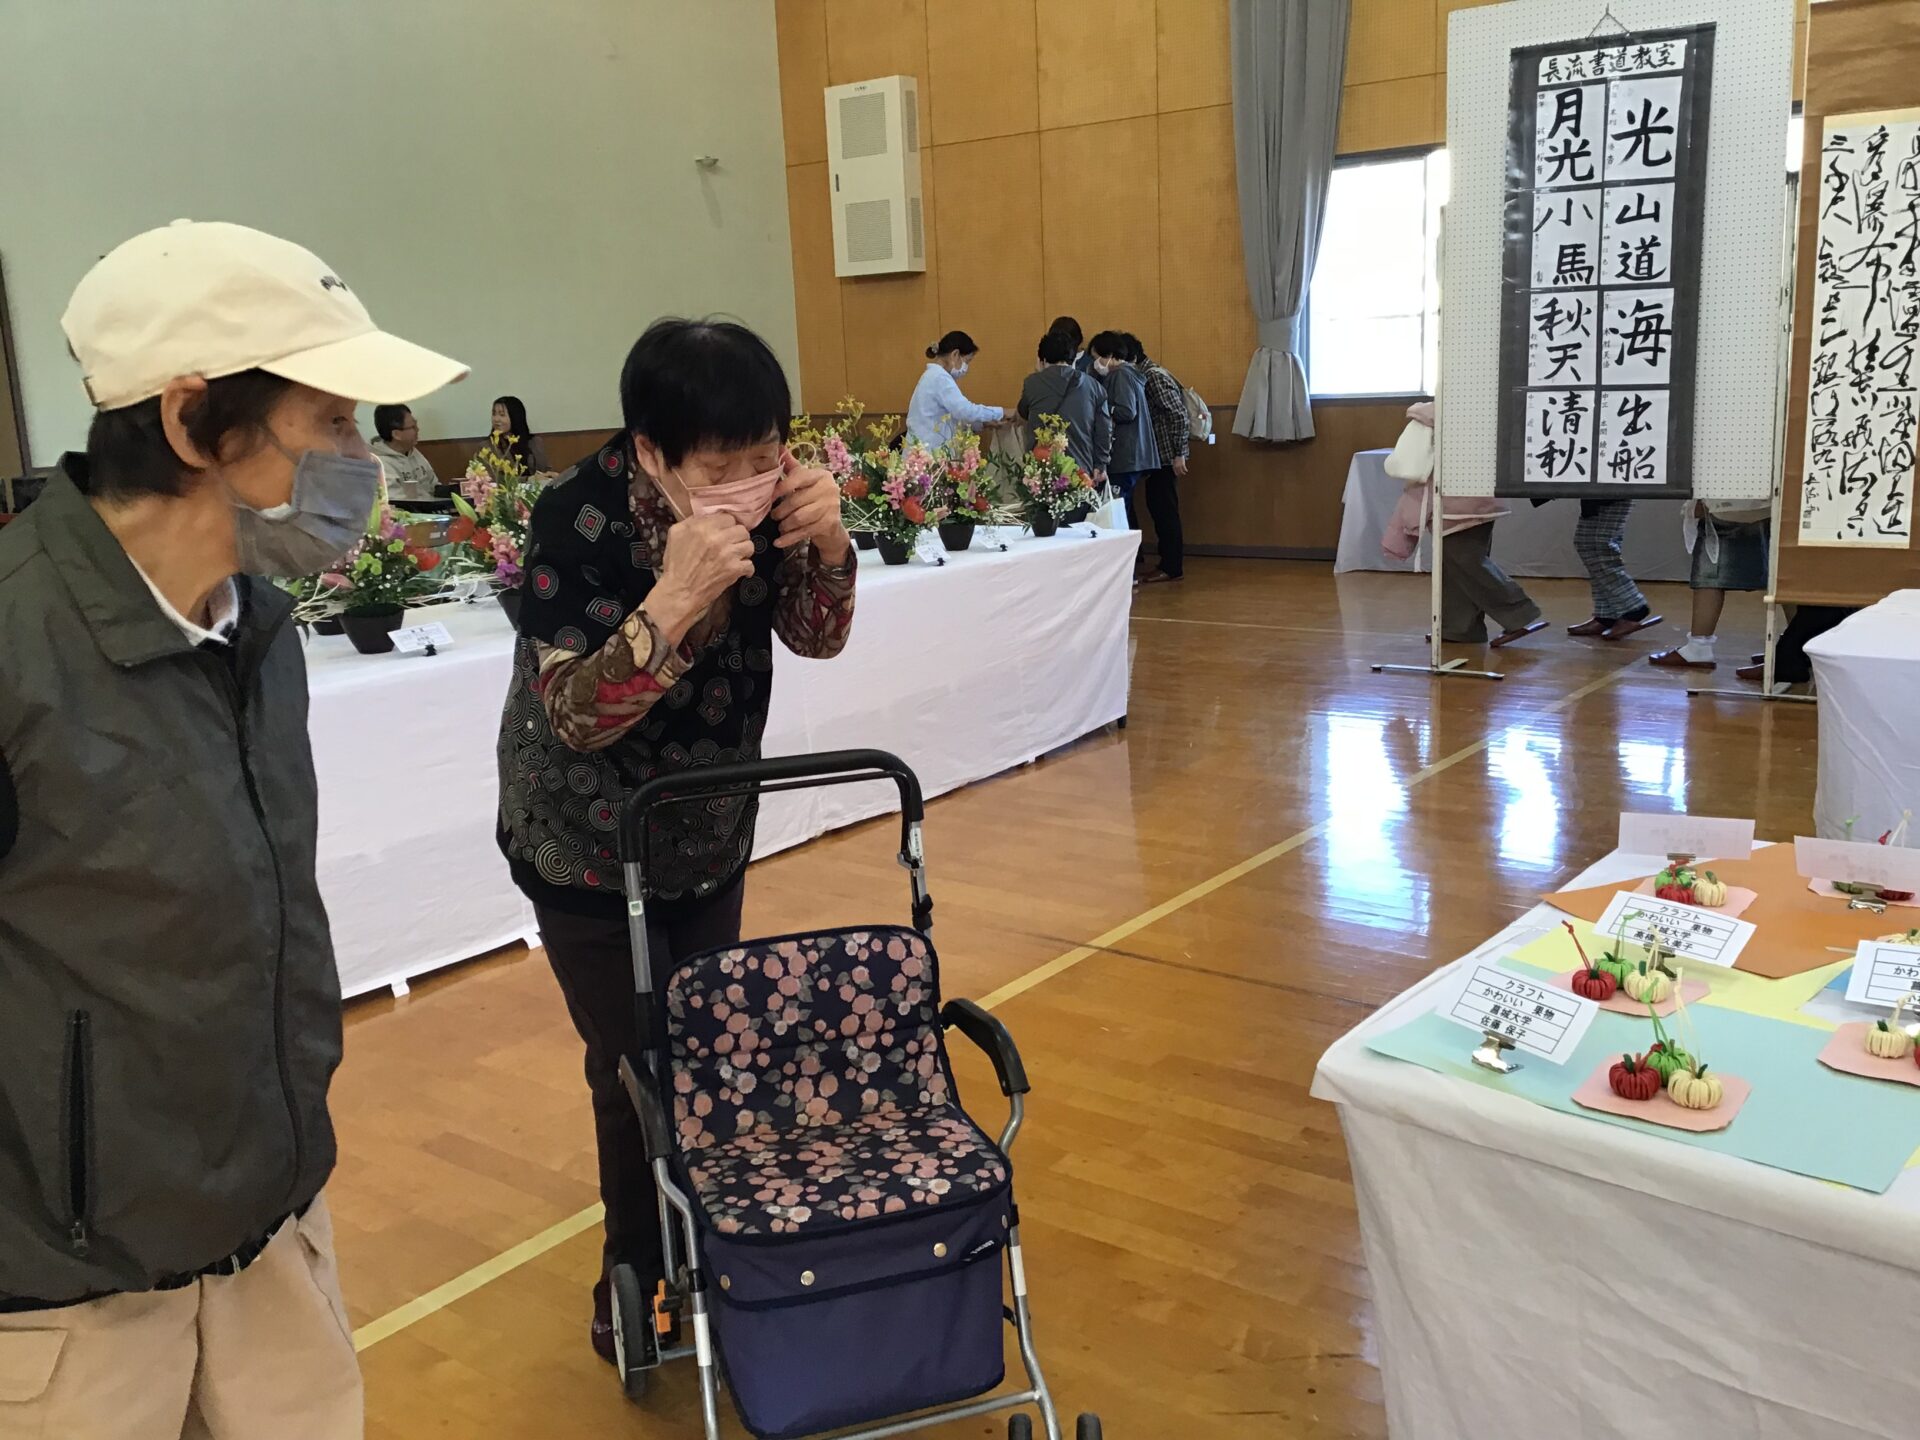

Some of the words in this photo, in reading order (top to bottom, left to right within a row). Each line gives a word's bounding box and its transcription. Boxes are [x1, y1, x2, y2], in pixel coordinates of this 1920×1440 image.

[1544, 88, 1595, 183] 月光
[1611, 98, 1674, 167] 光
[1533, 198, 1595, 285] 小馬
[1614, 193, 1667, 281] 山道
[1533, 297, 1592, 381] 秋天
[1608, 299, 1673, 367] 海
[1535, 391, 1588, 478] 清秋
[1607, 394, 1656, 482] 出船
[1648, 924, 1692, 940] 城大学
[1659, 906, 1700, 921] クラフト
[1481, 986, 1524, 1007] かわいい
[1532, 1004, 1556, 1021] 果物
[1504, 980, 1545, 1001] クラフト
[1480, 1015, 1502, 1031] 佐藤
[1504, 1024, 1527, 1039] 保子
